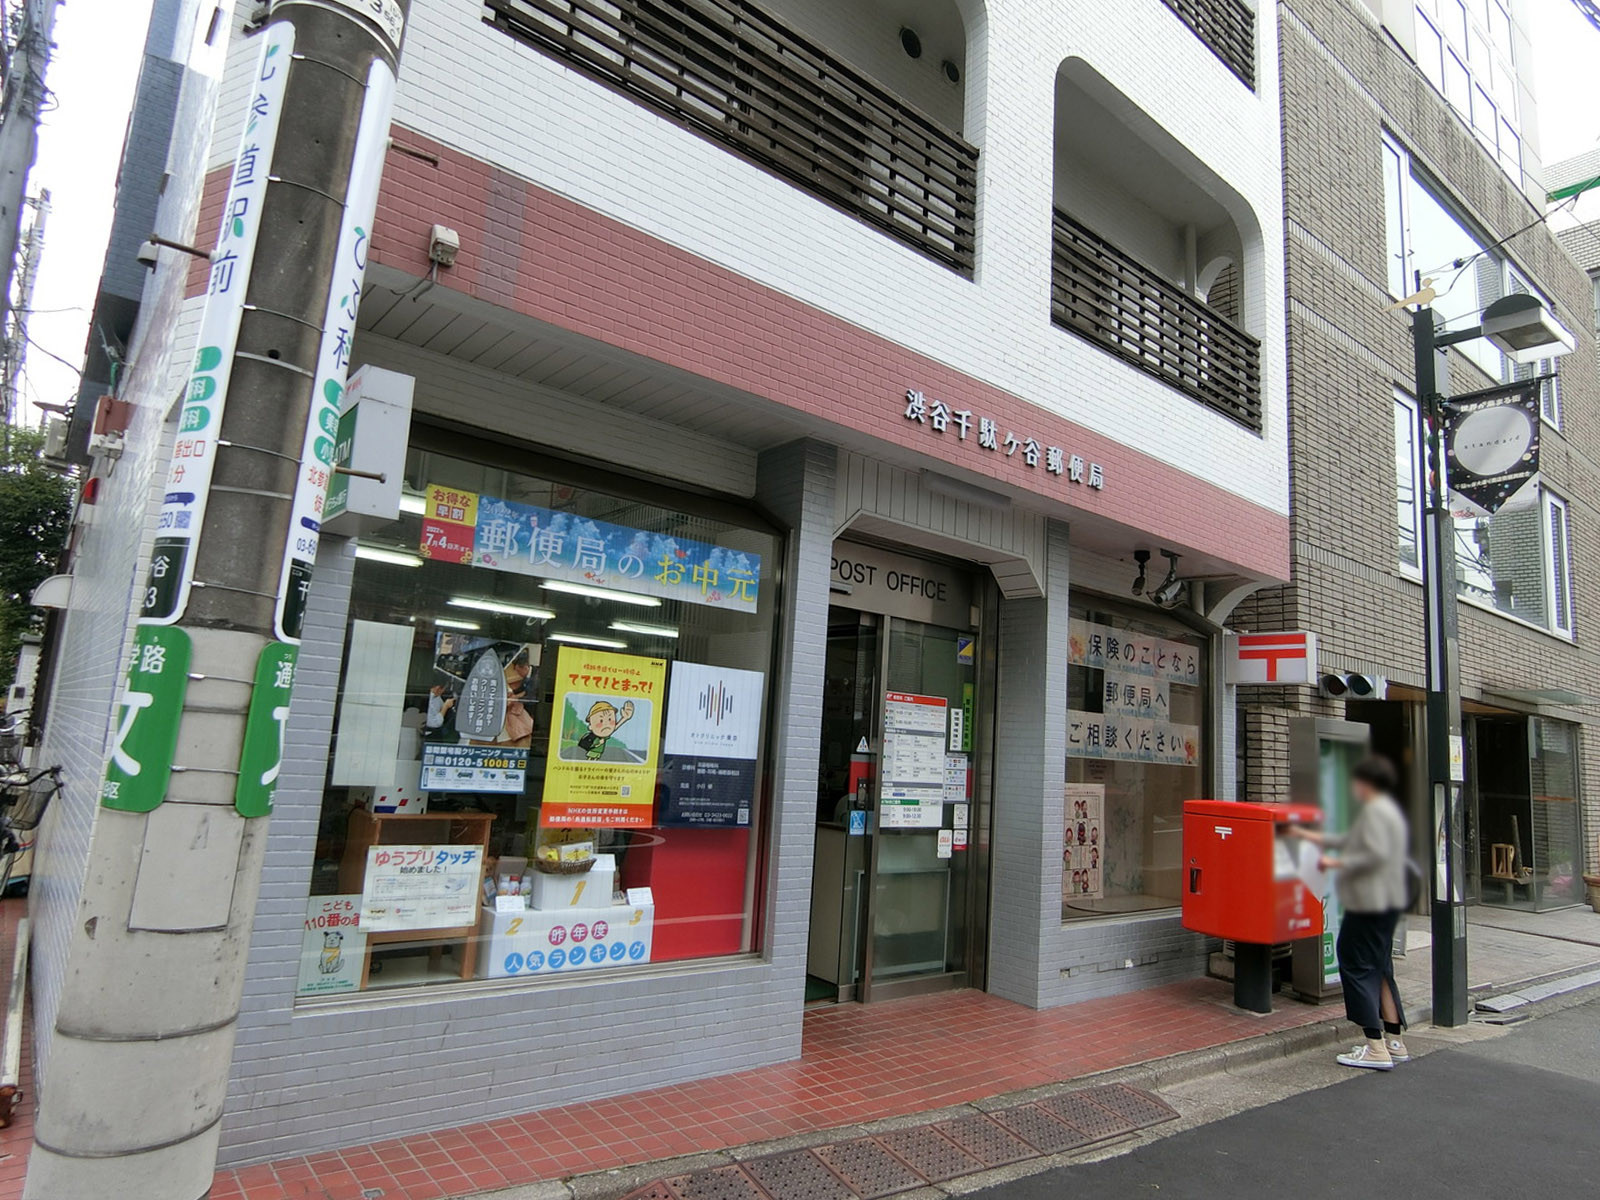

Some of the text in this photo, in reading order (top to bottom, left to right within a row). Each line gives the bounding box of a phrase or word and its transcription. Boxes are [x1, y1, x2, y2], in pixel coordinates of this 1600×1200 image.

[1464, 434, 1520, 450] standard
[432, 488, 471, 508] お得な
[436, 504, 464, 521] 早割
[479, 519, 756, 602] 郵便局のお中元
[831, 557, 947, 602] POST OFFICE
[1088, 633, 1196, 675] 保険のことなら
[1105, 681, 1167, 709] 郵便局へ
[1069, 721, 1184, 752] ご相談ください
[375, 849, 476, 867] ゆうプリタッチ
[570, 880, 587, 906] 1
[323, 900, 354, 912] こども
[505, 917, 524, 936] 2
[628, 909, 644, 926] 3
[551, 922, 608, 943] 昨年度
[507, 943, 645, 970] 人気ランキング
